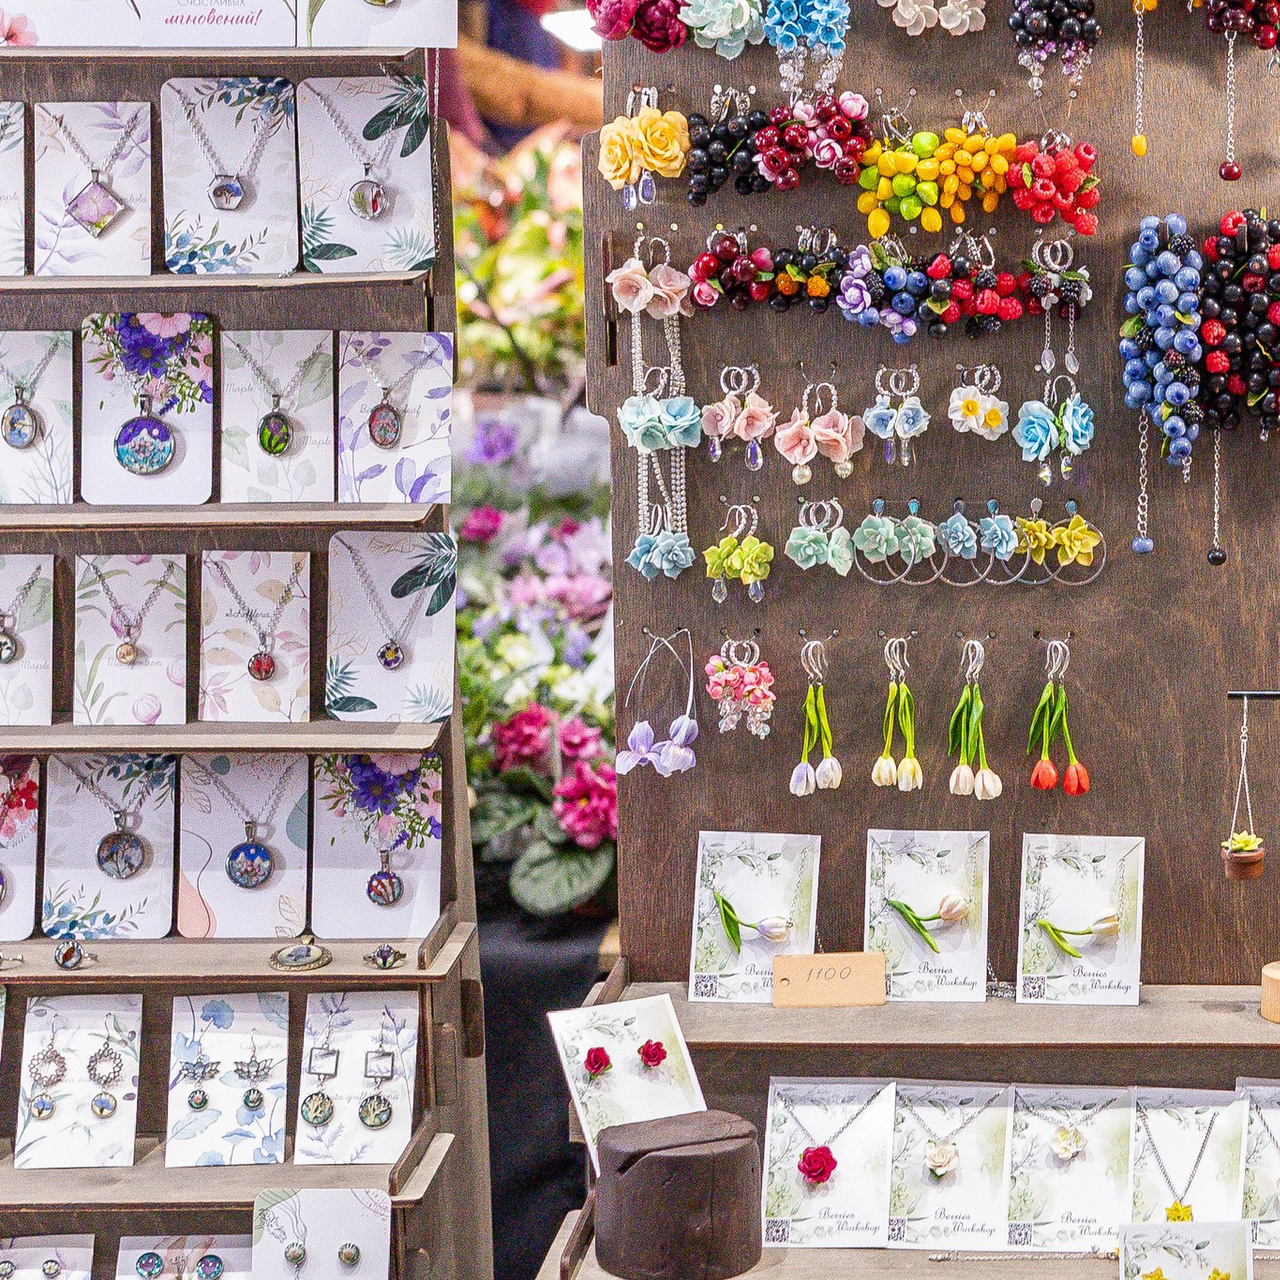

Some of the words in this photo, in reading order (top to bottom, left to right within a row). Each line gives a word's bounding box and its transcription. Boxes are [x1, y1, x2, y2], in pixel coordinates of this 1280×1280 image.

[164, 7, 263, 26] мгновений!
[806, 966, 852, 983] 1100
[918, 961, 953, 974] Berries
[1072, 964, 1108, 978] Berries
[935, 974, 978, 990] Workshop
[1089, 978, 1132, 994] Workshop
[818, 1206, 855, 1220] Berries
[934, 1206, 971, 1221] Berries
[1060, 1211, 1098, 1224] Berries
[836, 1220, 881, 1235] Workshop
[951, 1220, 997, 1238] Workshop
